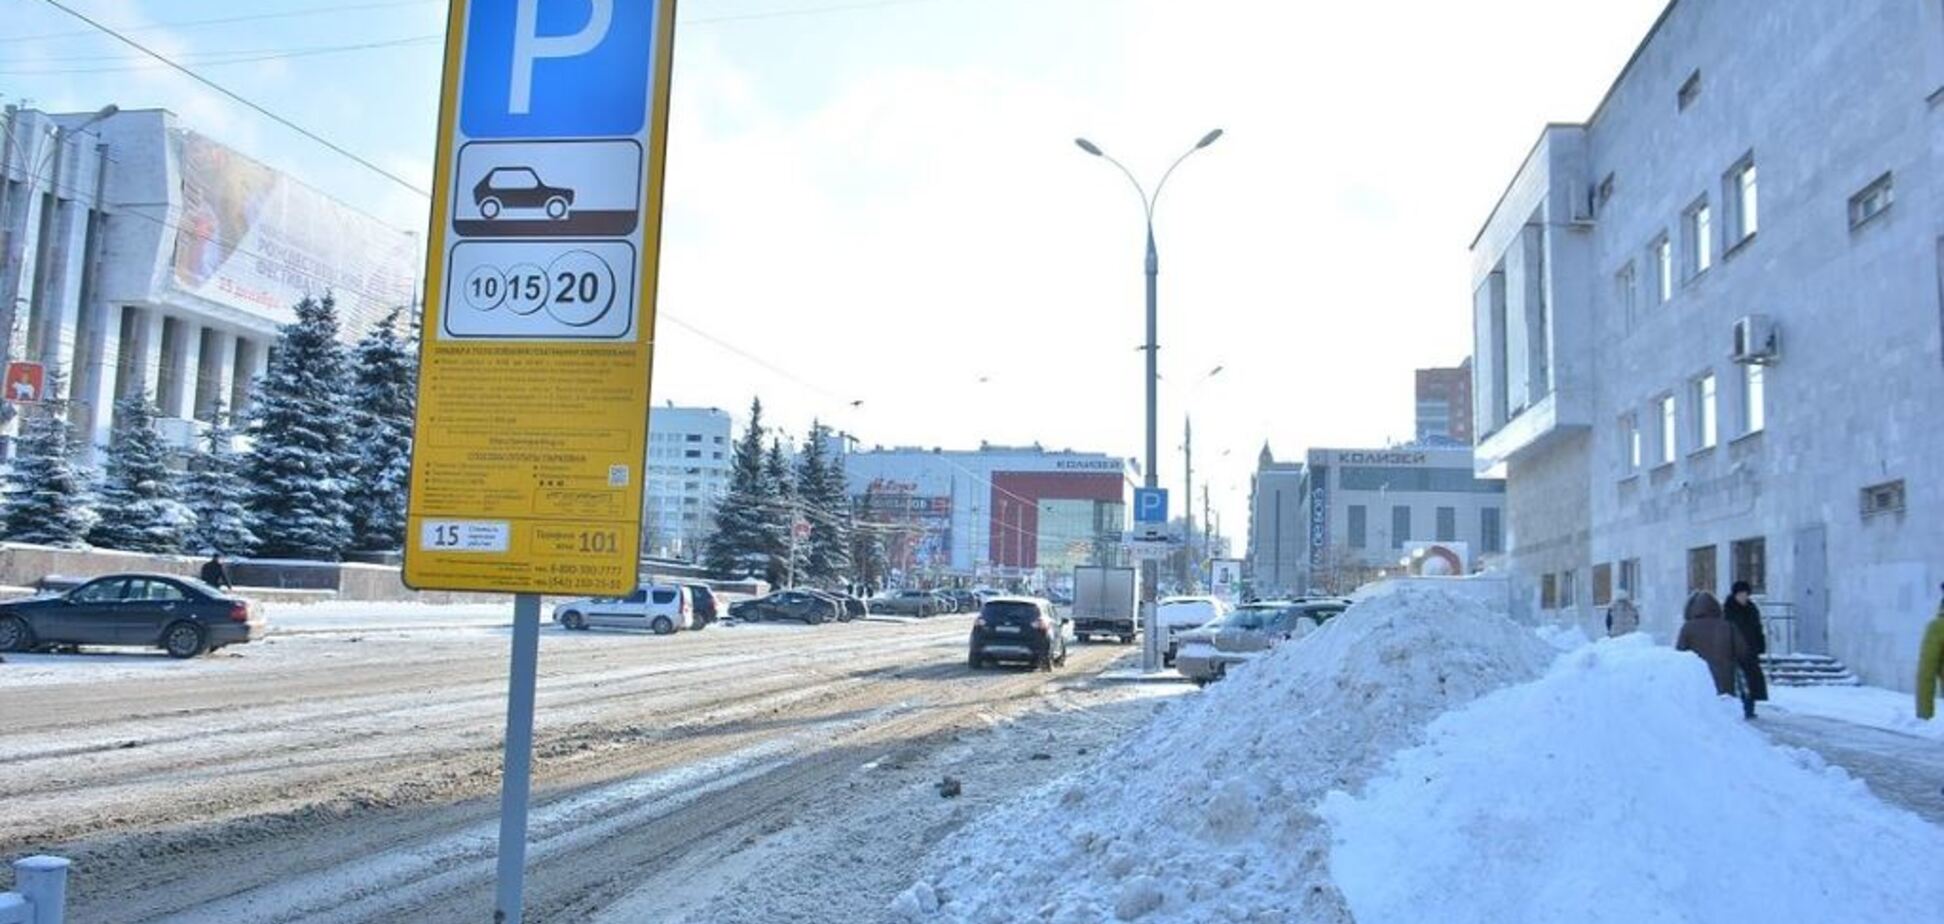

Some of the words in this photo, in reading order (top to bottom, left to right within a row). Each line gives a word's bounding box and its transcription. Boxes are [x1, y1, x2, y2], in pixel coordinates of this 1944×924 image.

[508, 0, 614, 115] P
[471, 277, 498, 298] 10
[509, 274, 542, 301] 15
[556, 272, 599, 304] 20
[1142, 491, 1160, 522] P
[434, 525, 460, 547] 15
[579, 531, 618, 553] 101
